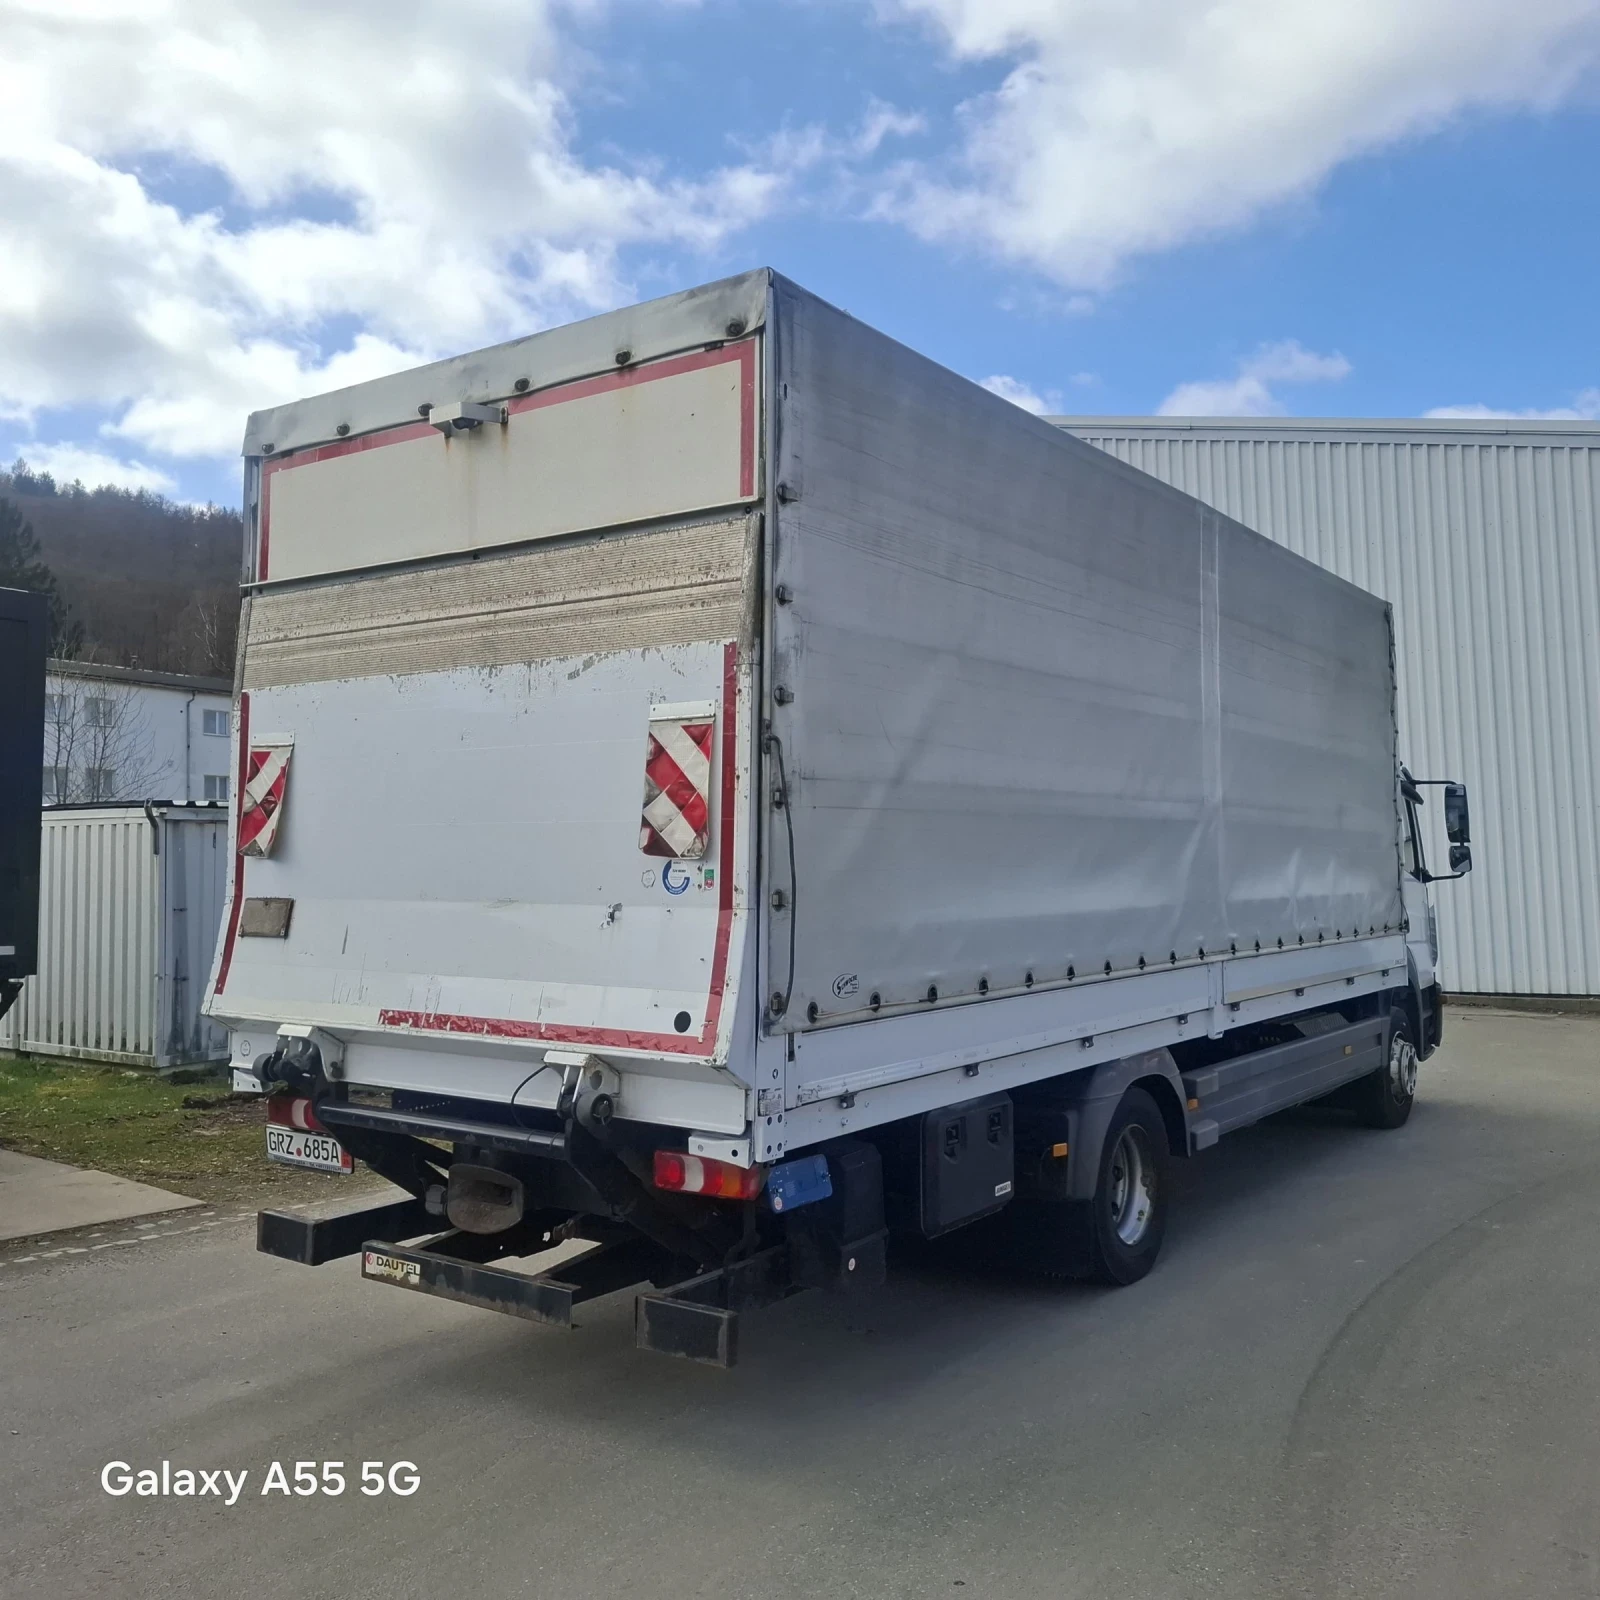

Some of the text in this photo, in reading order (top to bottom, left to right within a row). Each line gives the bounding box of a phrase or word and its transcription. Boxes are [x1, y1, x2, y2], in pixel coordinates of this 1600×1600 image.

[268, 1131, 340, 1163] GRZ 685A
[376, 1255, 420, 1276] DAUTEL
